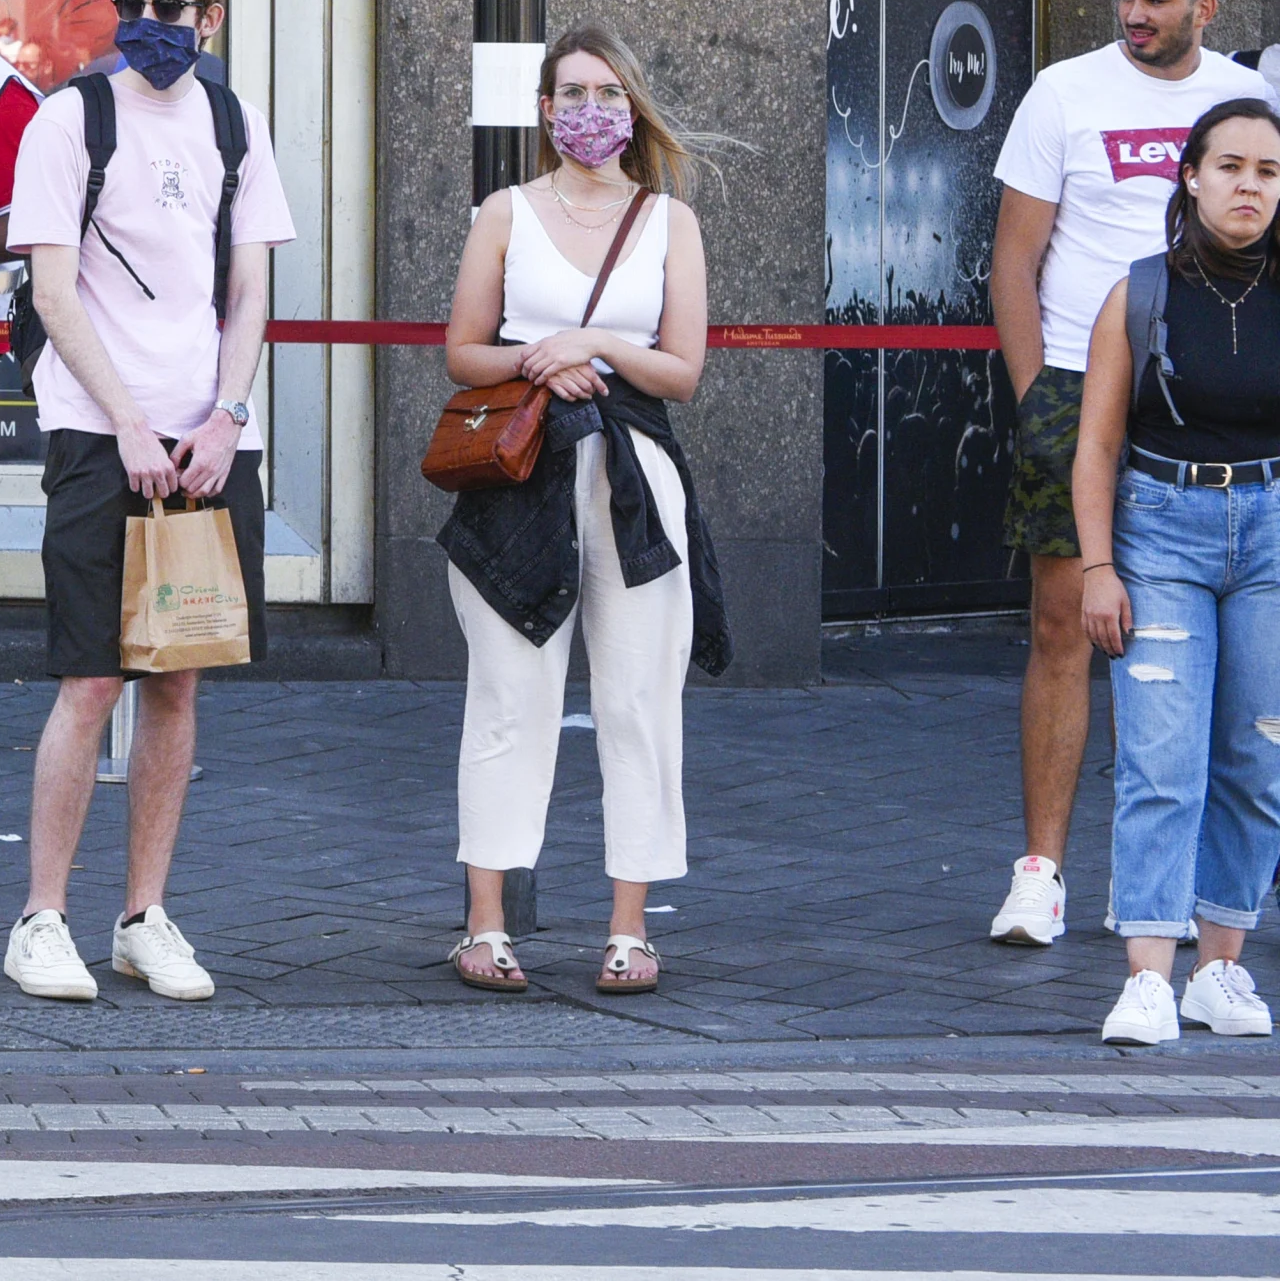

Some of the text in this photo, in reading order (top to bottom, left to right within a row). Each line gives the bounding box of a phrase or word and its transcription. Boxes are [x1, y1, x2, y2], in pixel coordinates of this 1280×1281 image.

[948, 51, 985, 84] Try Me!
[722, 327, 802, 341] Madame Tussauds
